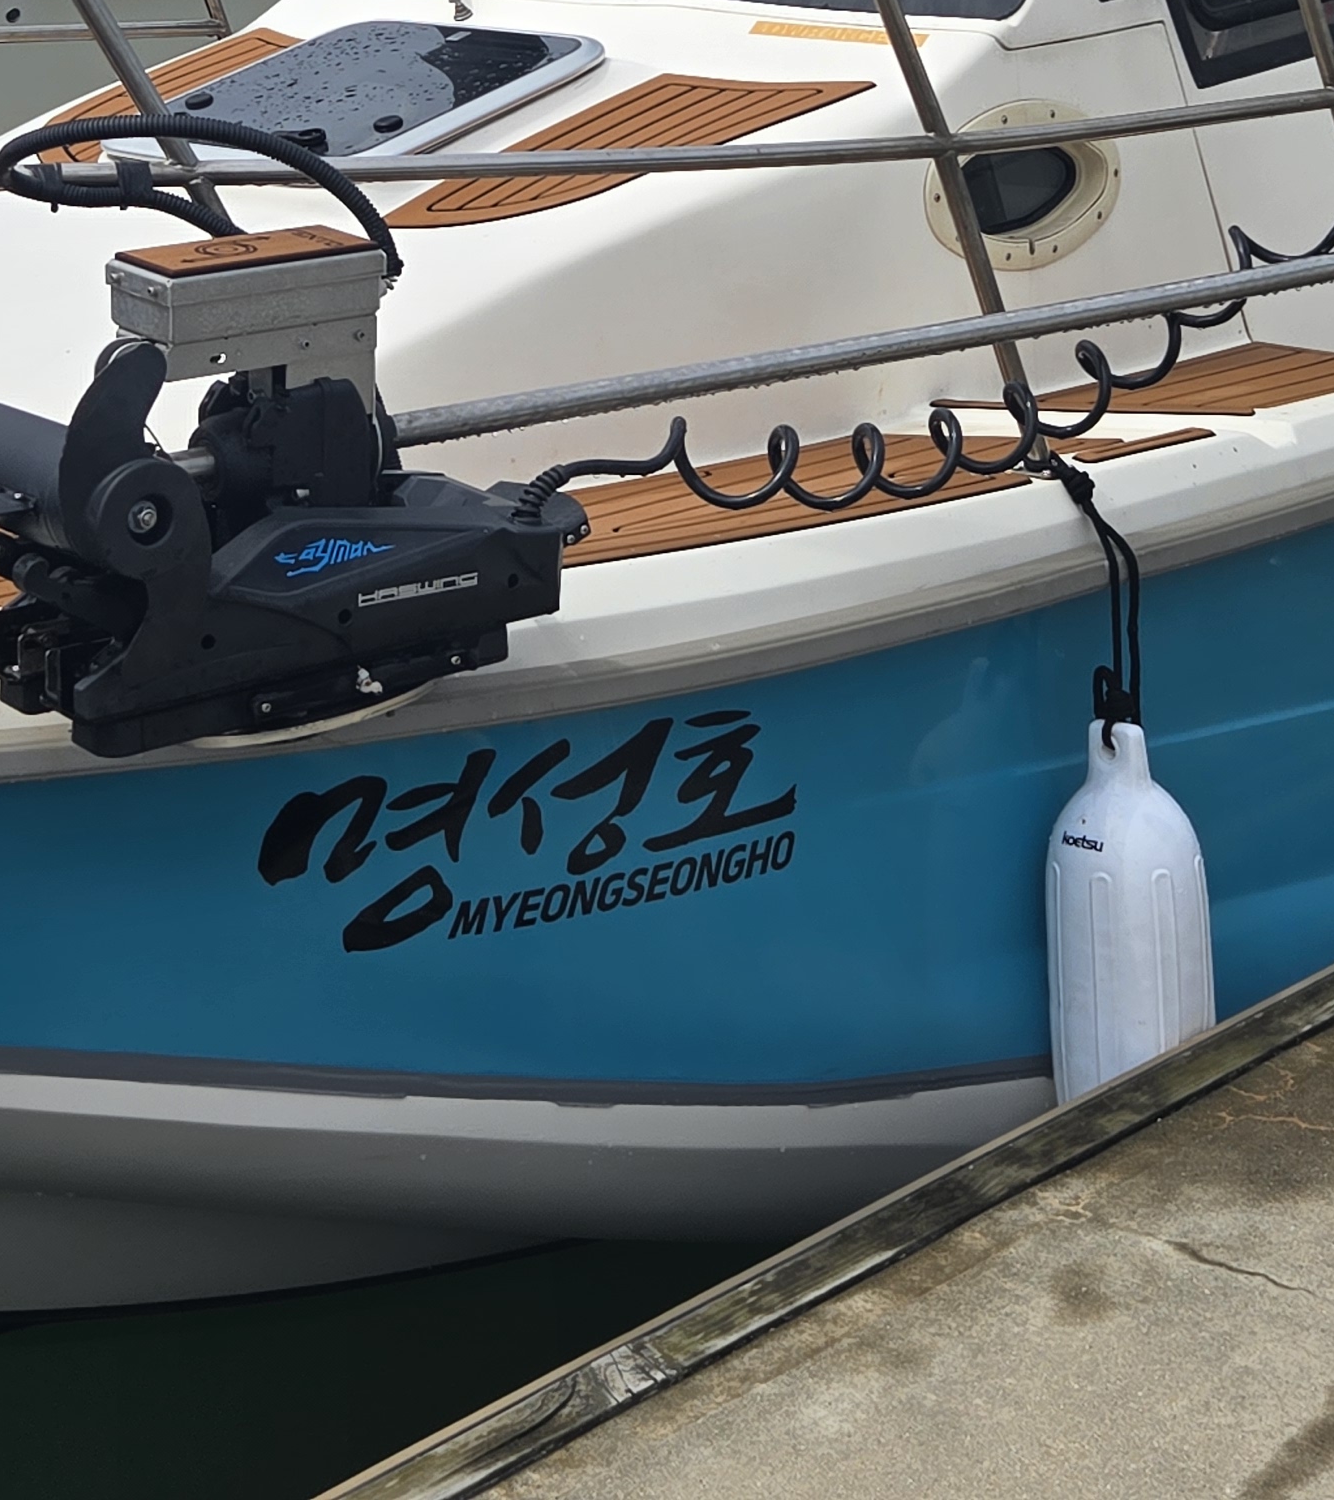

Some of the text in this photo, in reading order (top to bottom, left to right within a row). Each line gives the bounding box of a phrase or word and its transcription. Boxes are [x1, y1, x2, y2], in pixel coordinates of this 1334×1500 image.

[257, 710, 797, 953] 명성호
[447, 830, 796, 940] MYEONGSEONGHO
[1061, 830, 1104, 853] koetsu
